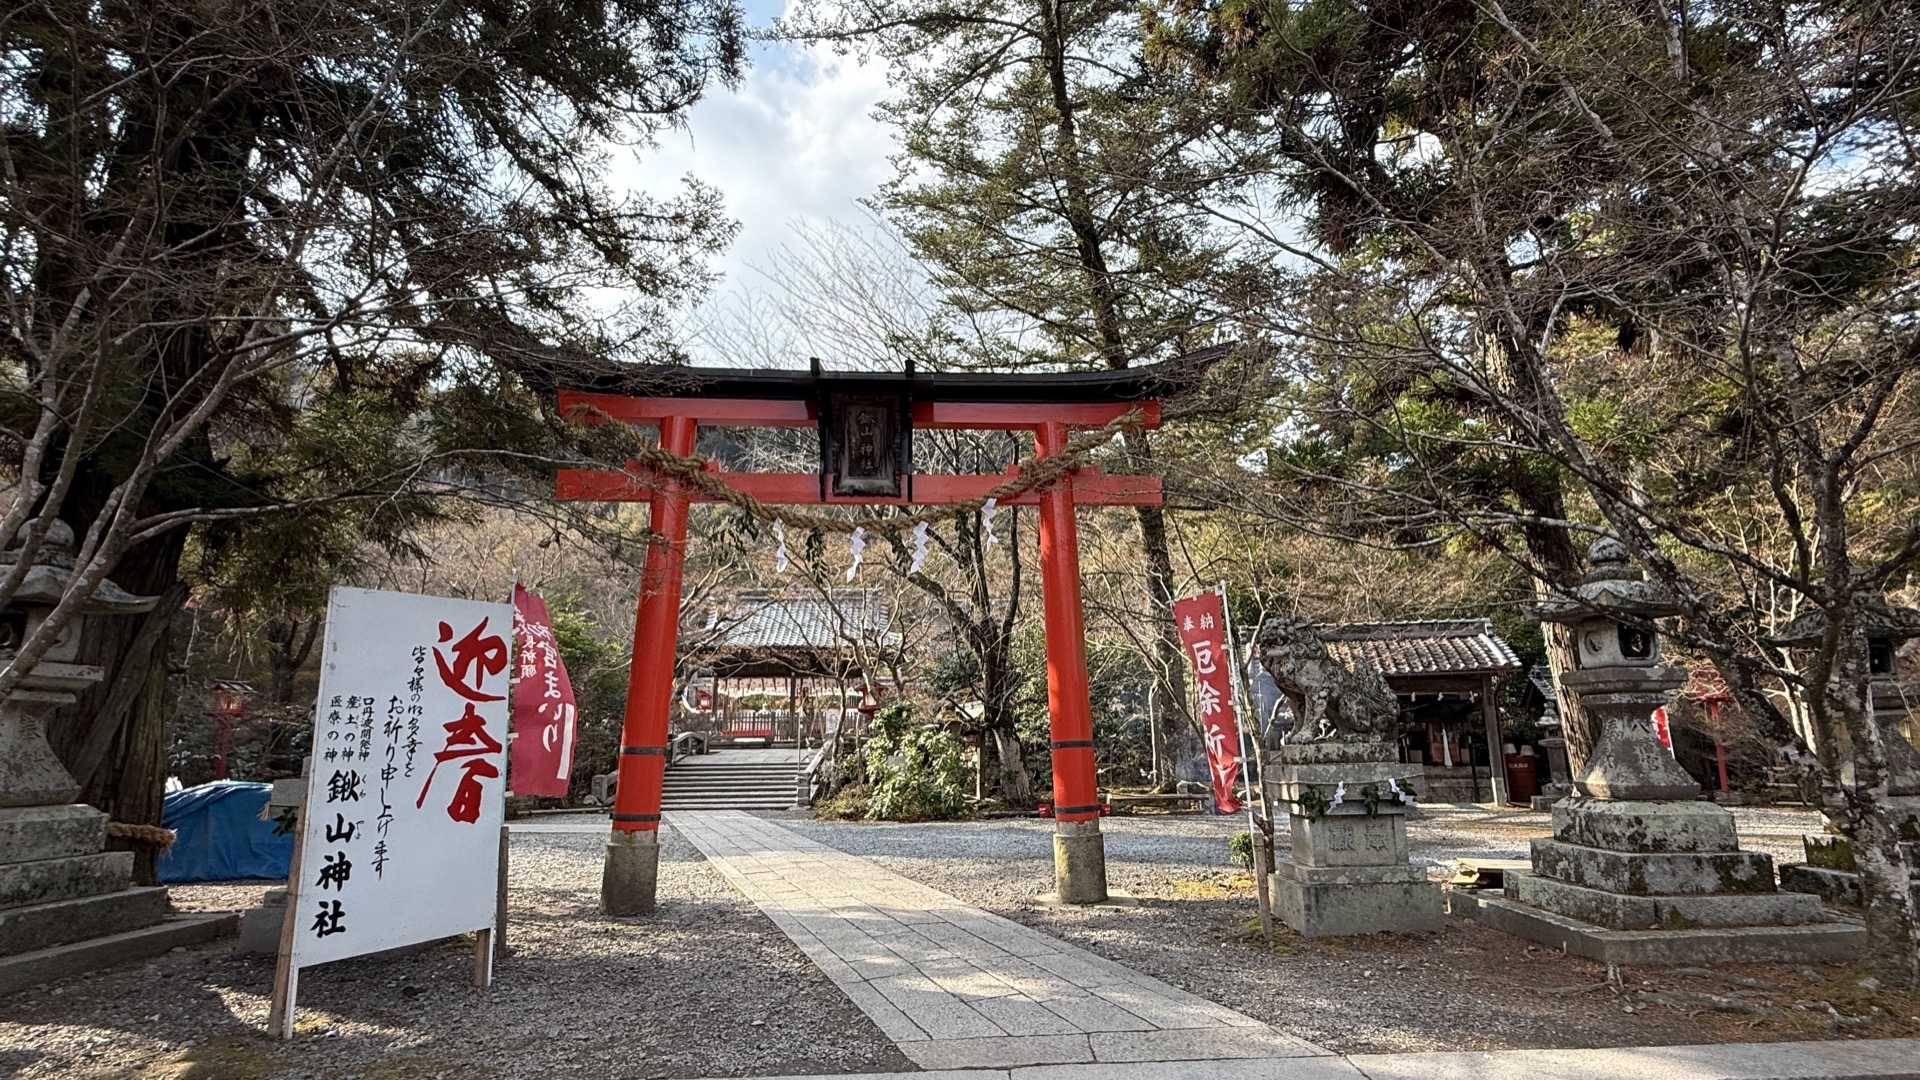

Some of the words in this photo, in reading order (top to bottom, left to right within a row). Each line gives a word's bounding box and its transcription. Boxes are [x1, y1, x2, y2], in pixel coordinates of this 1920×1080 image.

[1183, 612, 1214, 632] 奉納
[323, 695, 342, 763] 医療の神
[341, 695, 359, 762] 産土の神
[371, 694, 404, 882] お祈り申し上げます
[417, 616, 507, 825] 迎春
[1191, 640, 1233, 788] 厄除祈
[310, 769, 360, 938] 鍬山神社
